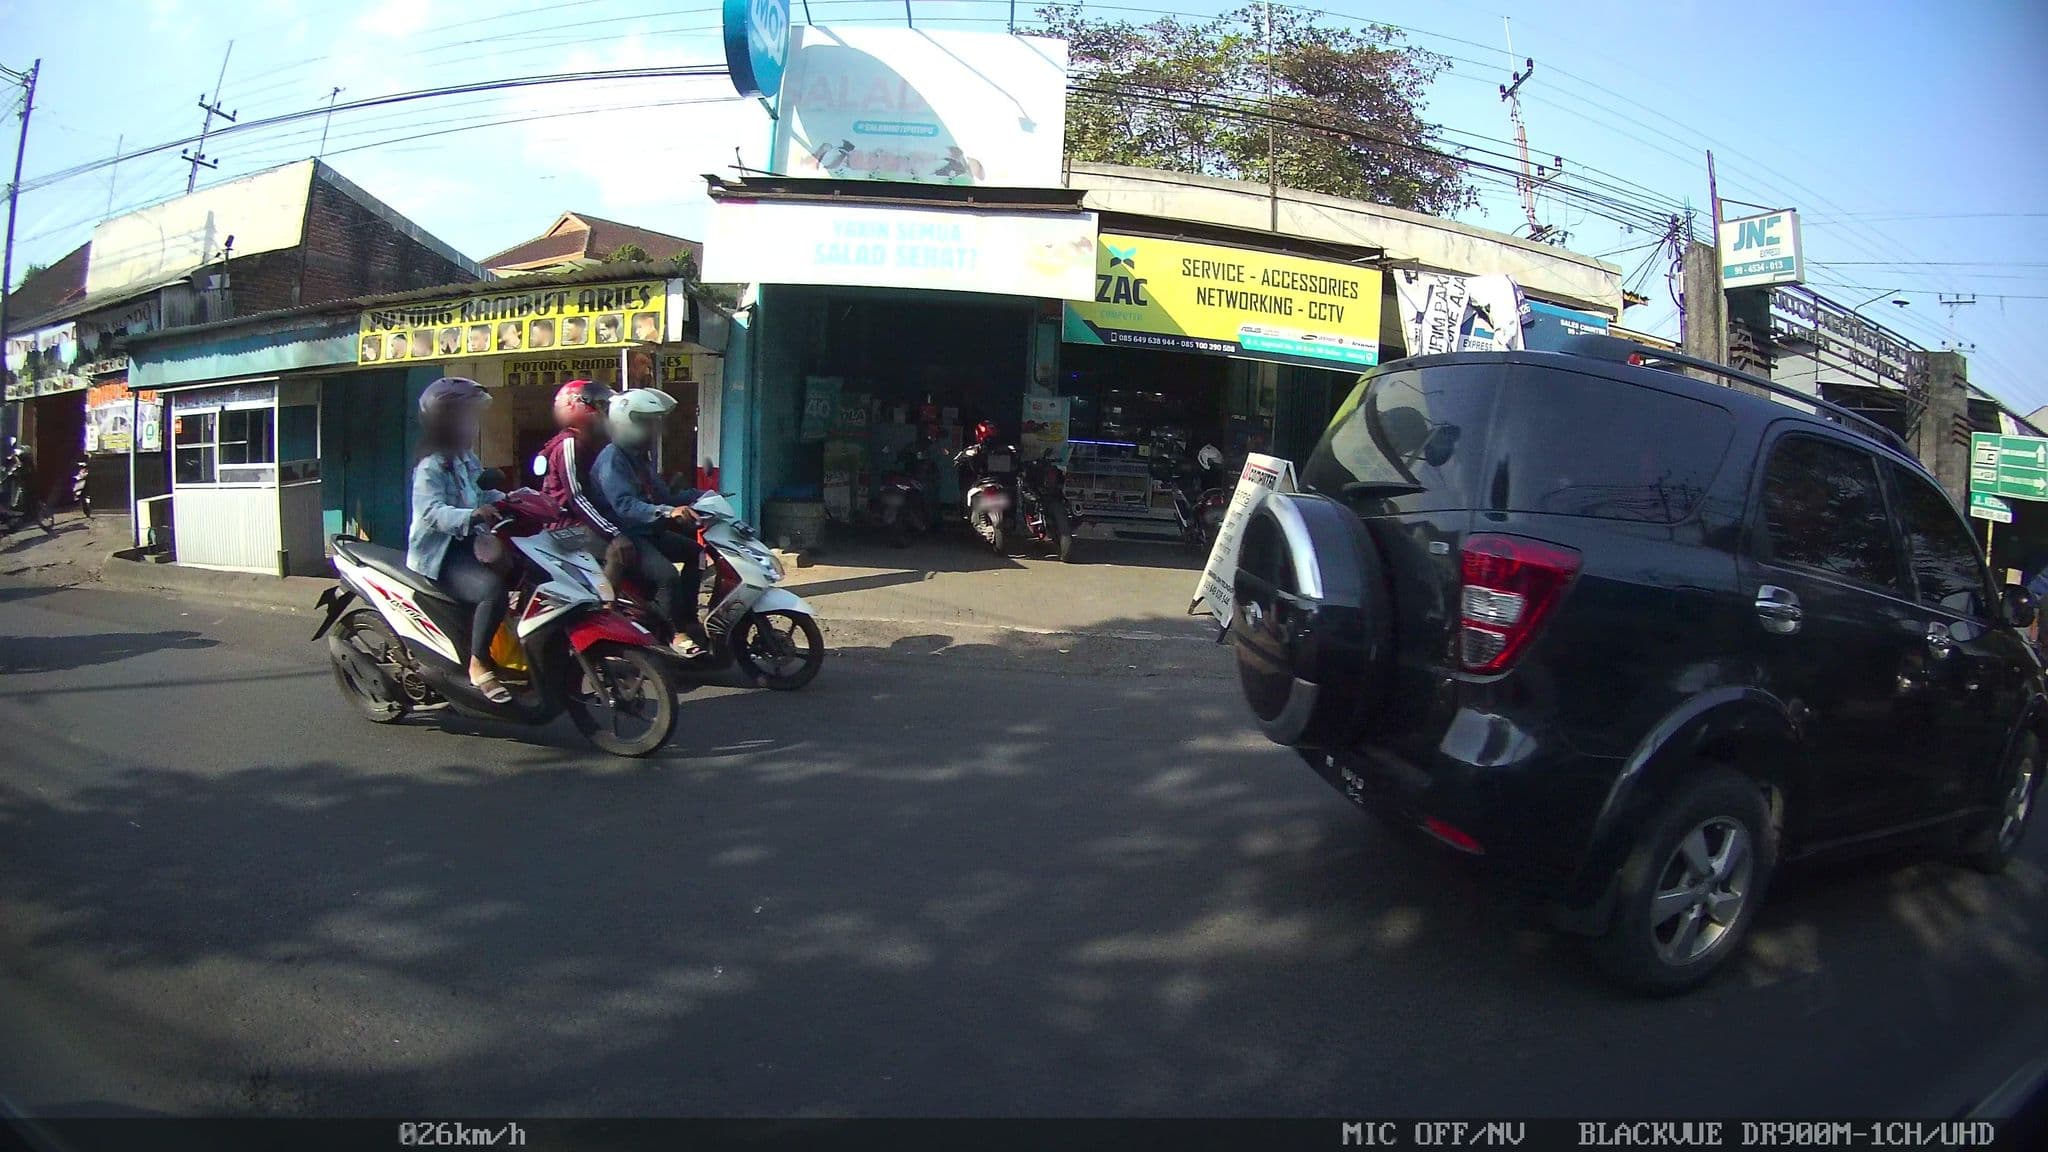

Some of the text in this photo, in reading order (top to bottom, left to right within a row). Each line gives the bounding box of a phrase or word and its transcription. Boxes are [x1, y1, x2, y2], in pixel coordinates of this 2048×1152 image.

[1096, 274, 1148, 306] ZAC
[1182, 258, 1245, 284] SERVICE
[1261, 268, 1359, 300] ACCESSORIES
[370, 284, 652, 332] POTONG RAMBUT ARIES
[1196, 286, 1293, 317] NETWORKING
[1308, 301, 1345, 324] CCTV
[1118, 334, 1133, 342] 085
[1133, 335, 1147, 344] 649
[1161, 338, 1175, 347] 944
[1181, 340, 1194, 348] 085
[1427, 317, 1446, 354] IRIM
[513, 359, 567, 373] POTONG
[572, 358, 622, 371] RAMBU
